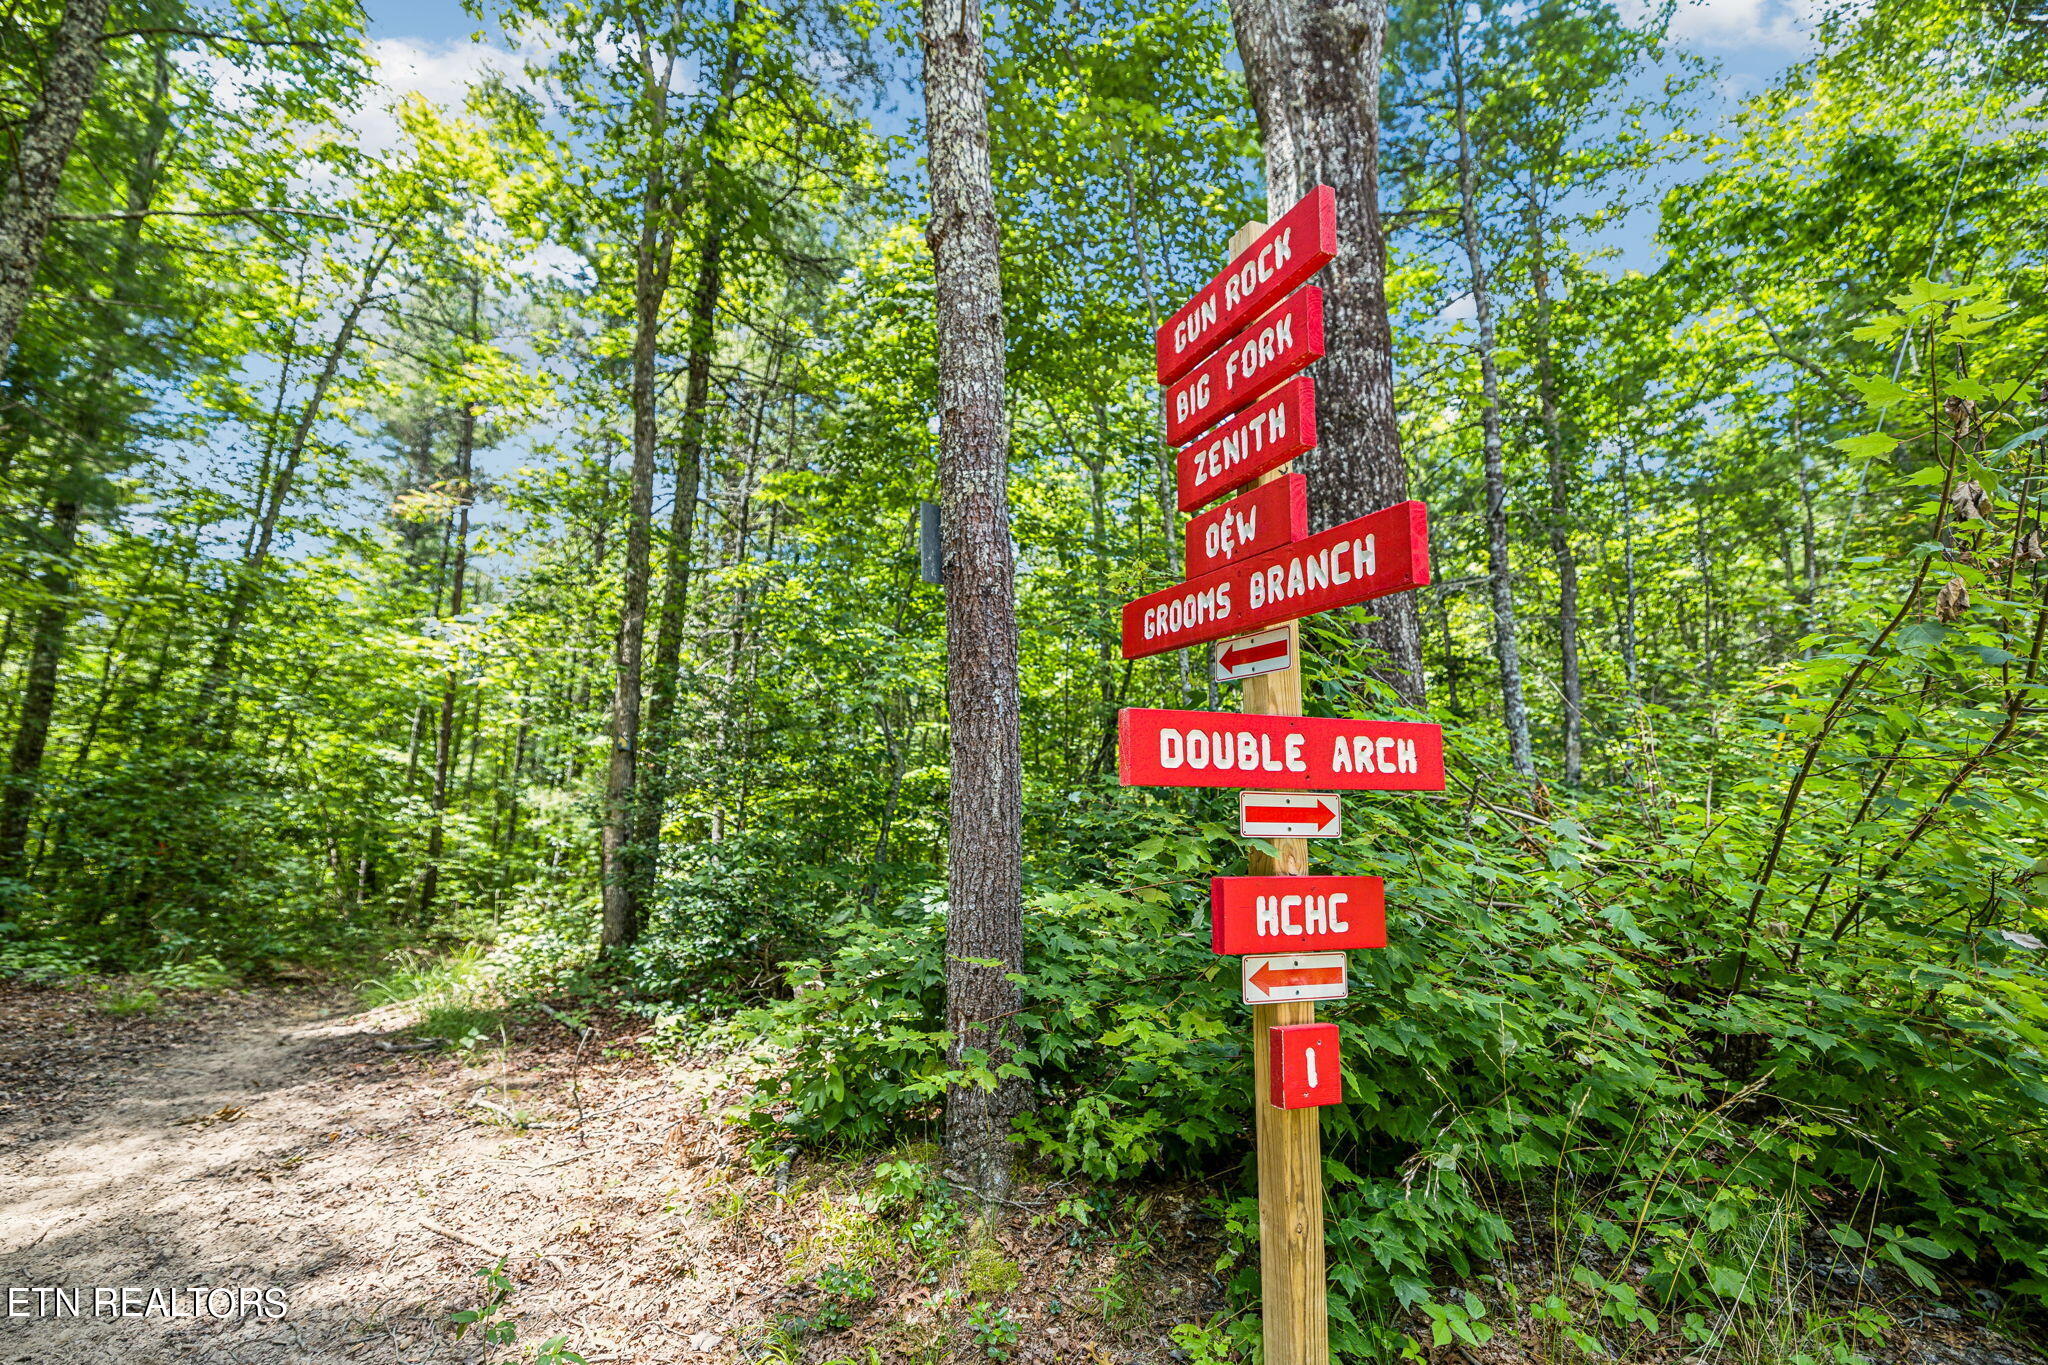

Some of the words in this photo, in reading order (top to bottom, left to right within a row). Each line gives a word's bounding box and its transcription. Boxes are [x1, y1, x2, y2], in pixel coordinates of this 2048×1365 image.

[1174, 294, 1217, 354] GUN
[1225, 226, 1292, 312] ROCK
[1176, 373, 1210, 424] BIG
[1226, 312, 1293, 390] FORK
[1193, 402, 1286, 487] ZENITH
[1144, 582, 1231, 640] GROOMS
[1249, 533, 1376, 610] BRANCH
[1159, 727, 1307, 772] DOUBLE
[1332, 735, 1418, 774] ARCH
[1256, 892, 1349, 937] HCHC
